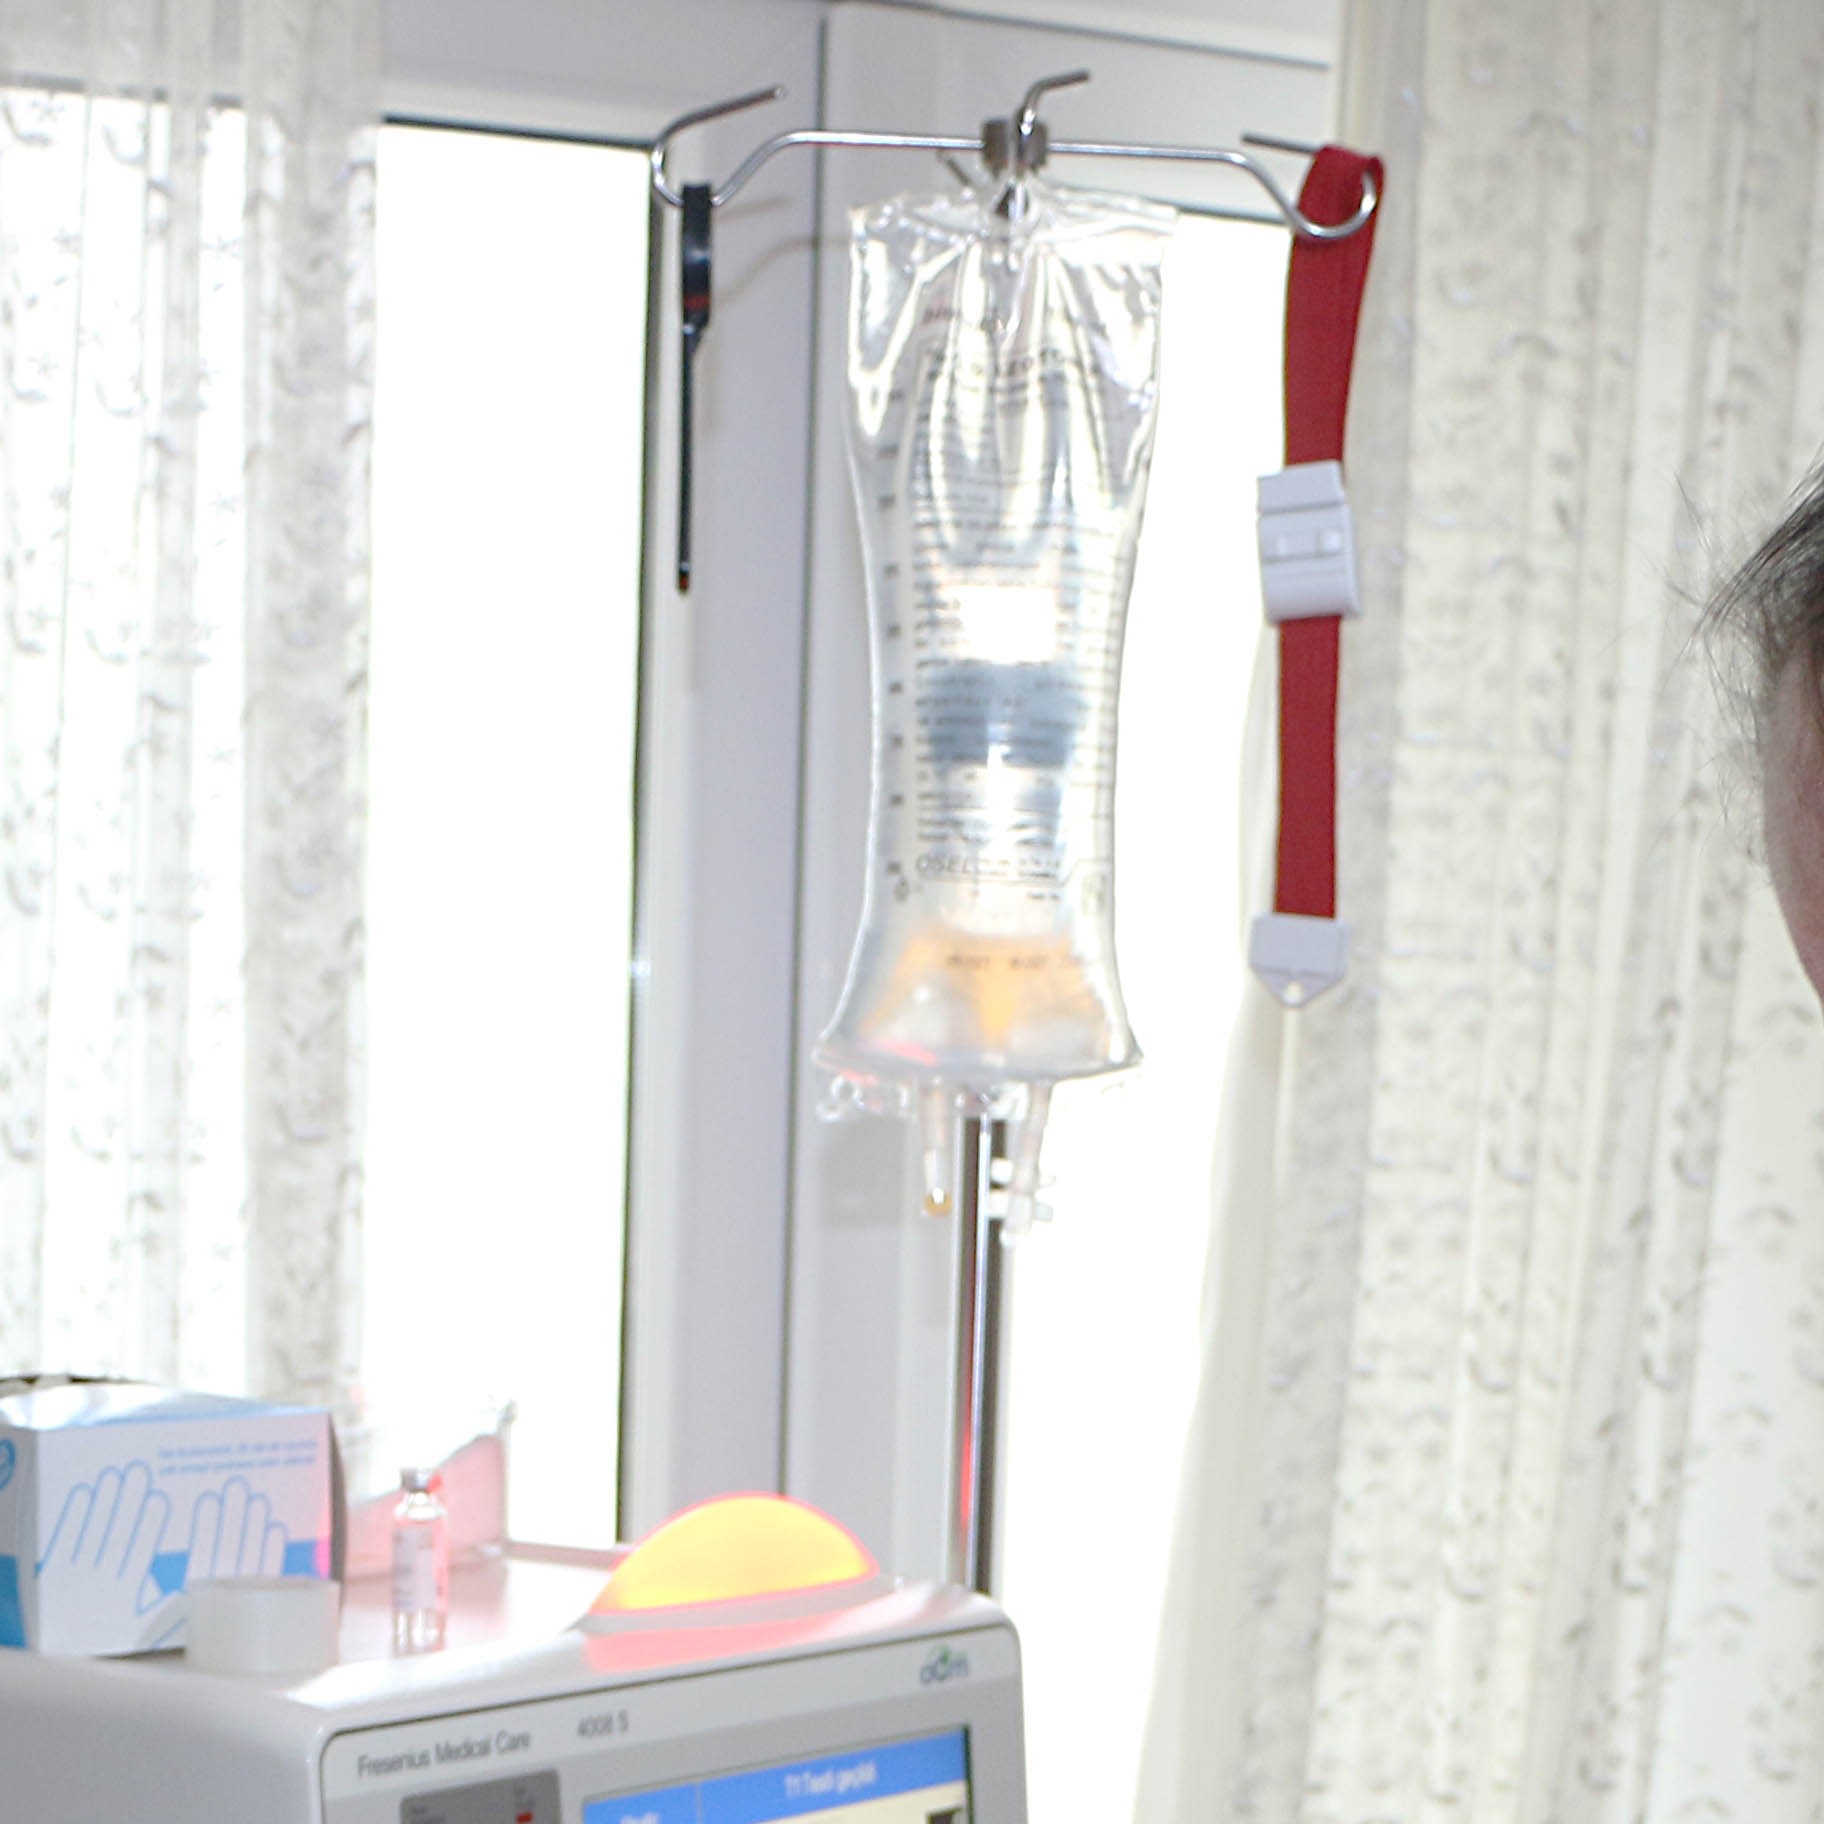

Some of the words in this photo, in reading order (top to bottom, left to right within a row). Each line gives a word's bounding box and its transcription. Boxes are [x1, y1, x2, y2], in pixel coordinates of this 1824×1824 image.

[577, 1713, 614, 1738] 4008
[619, 1709, 630, 1734] S
[358, 1749, 430, 1777] Fresenius
[435, 1732, 492, 1763] Medical
[495, 1729, 531, 1753] Care
